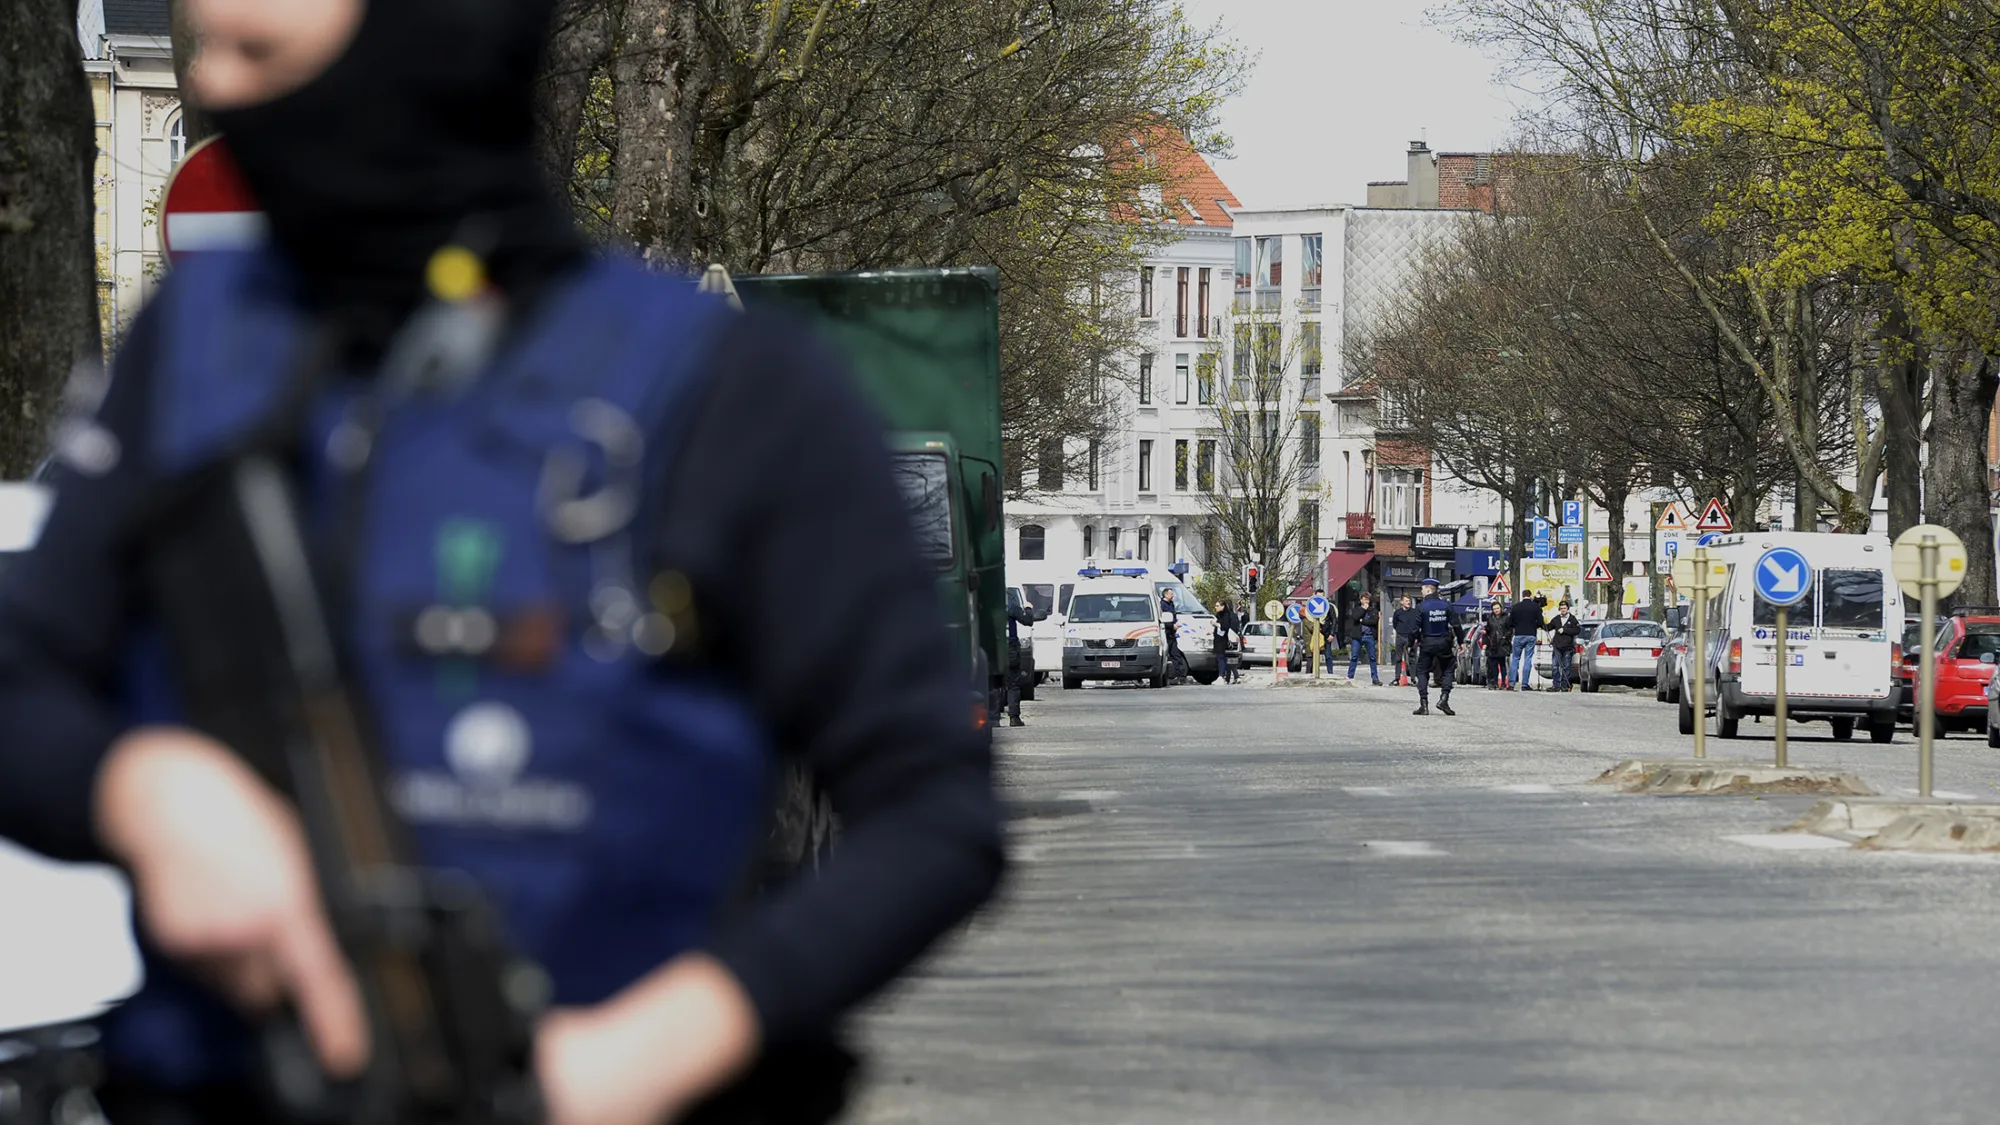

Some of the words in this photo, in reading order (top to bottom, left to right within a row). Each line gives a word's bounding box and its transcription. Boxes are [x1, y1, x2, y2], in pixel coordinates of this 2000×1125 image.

[1566, 503, 1576, 516] P
[1535, 520, 1547, 536] P
[1415, 532, 1454, 546] ATMOSPHERE
[1488, 556, 1509, 570] Les
[1771, 630, 1810, 640] Plitie
